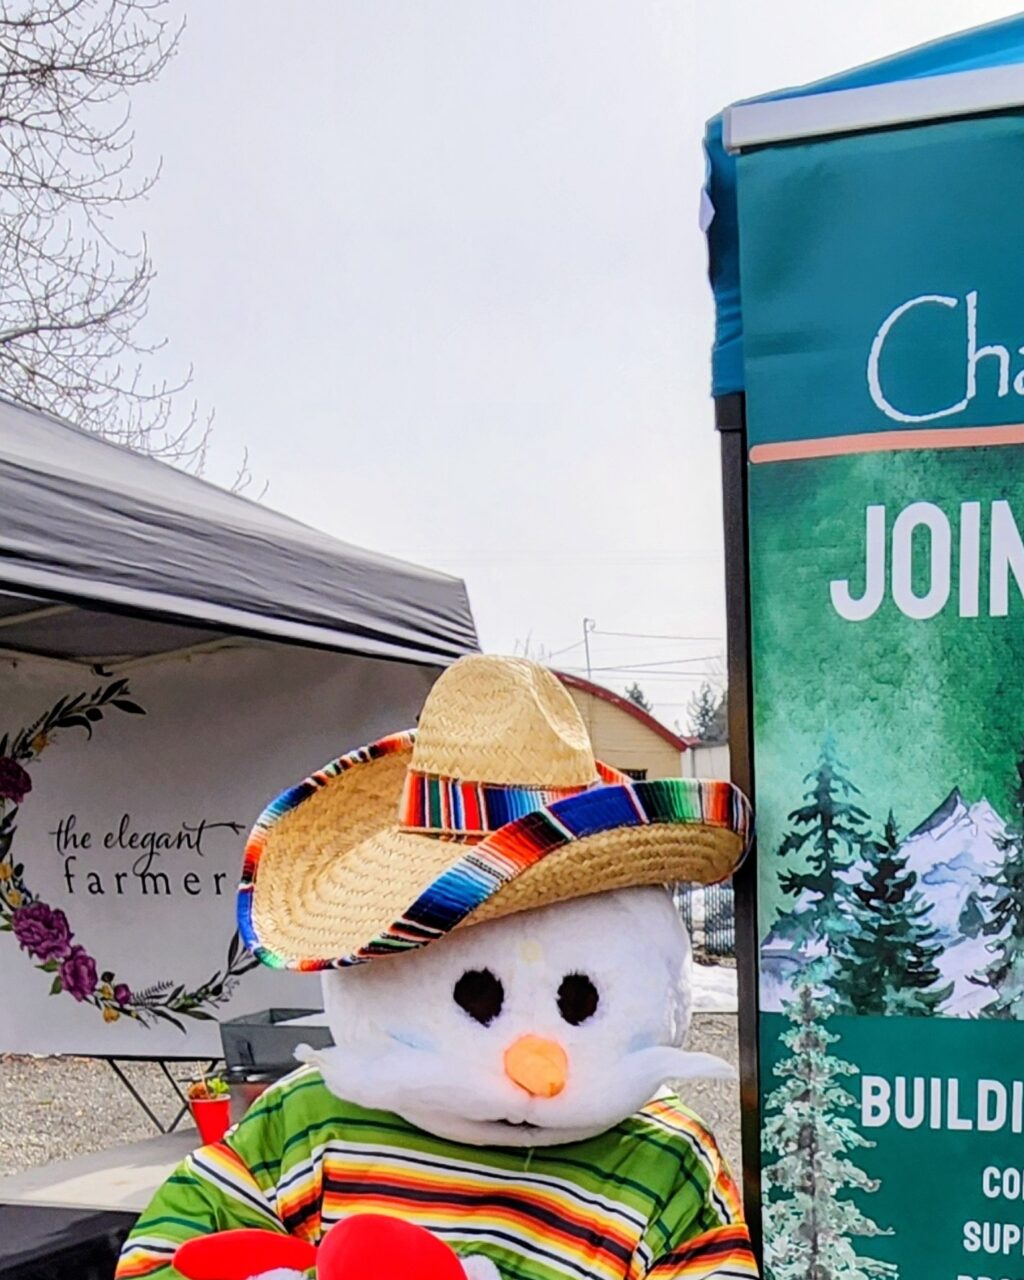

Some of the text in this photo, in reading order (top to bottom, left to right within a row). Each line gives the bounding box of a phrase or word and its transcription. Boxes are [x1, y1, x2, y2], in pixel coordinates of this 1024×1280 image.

[49, 814, 245, 877] the elegant
[64, 856, 226, 894] farmer
